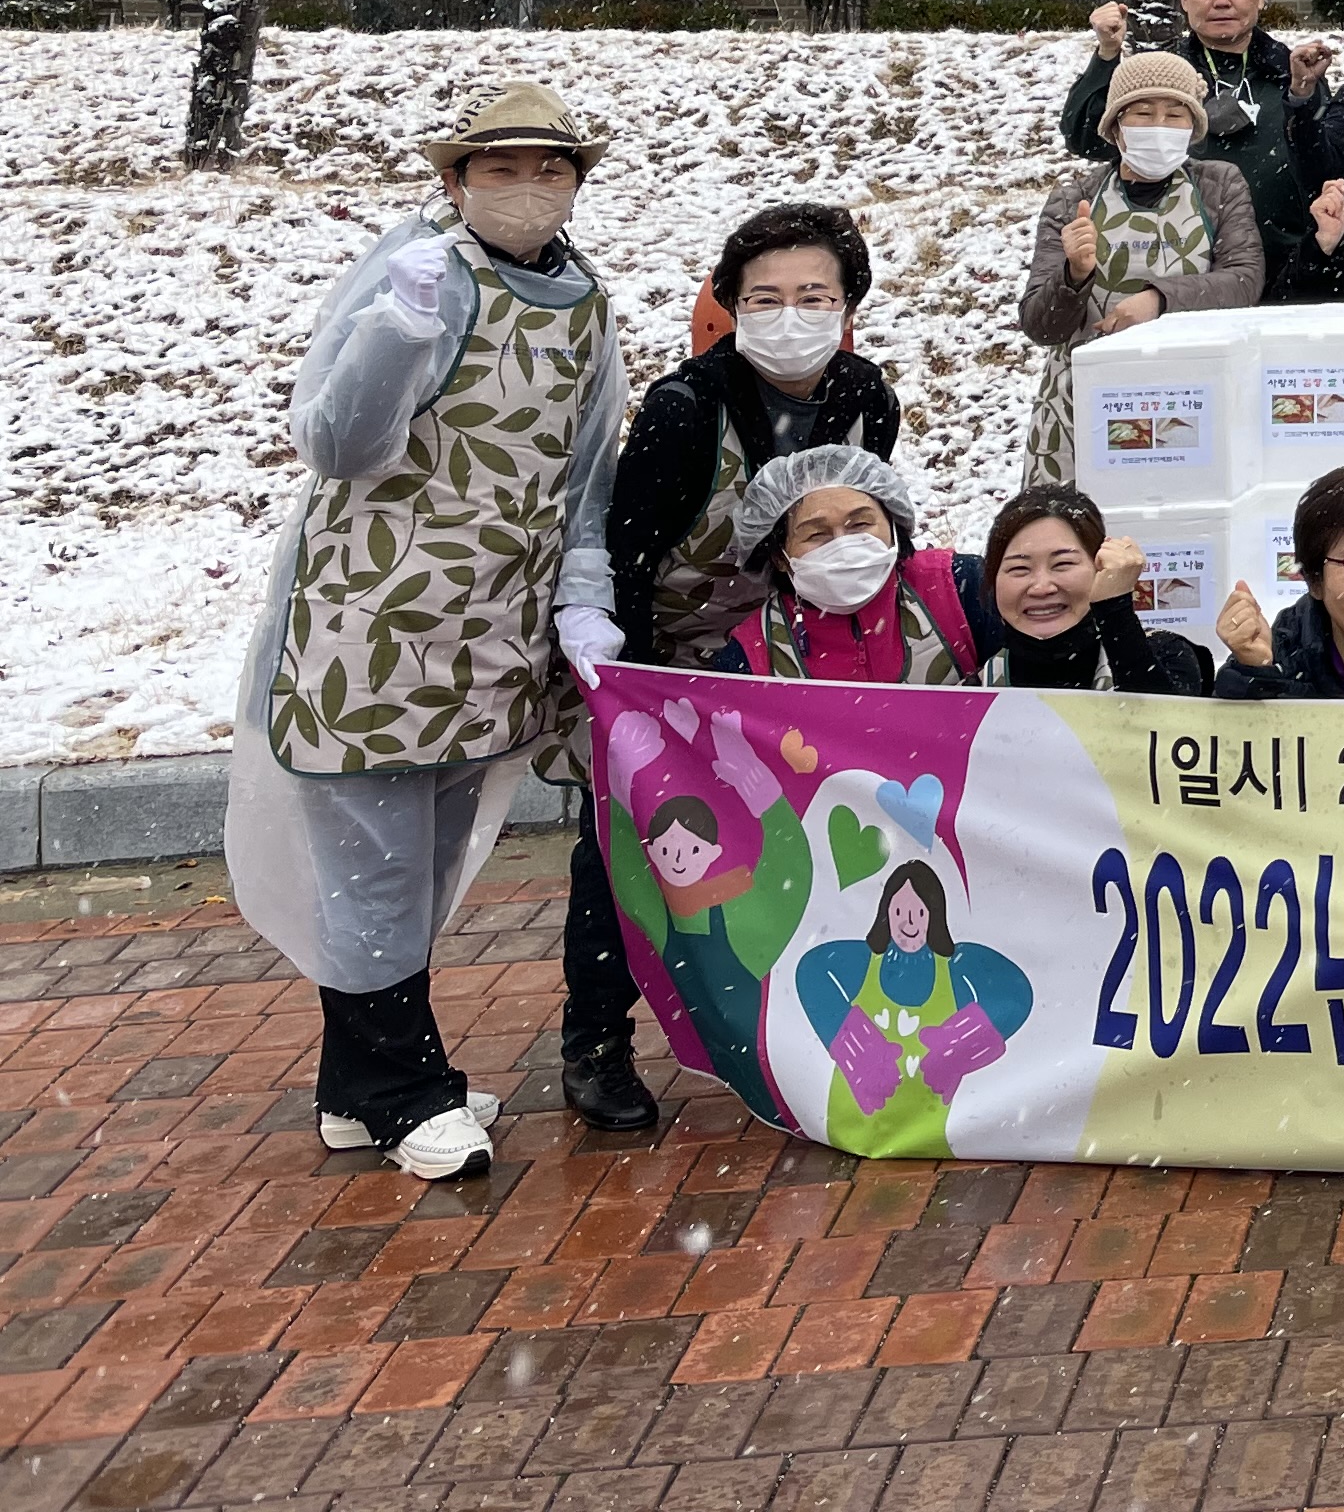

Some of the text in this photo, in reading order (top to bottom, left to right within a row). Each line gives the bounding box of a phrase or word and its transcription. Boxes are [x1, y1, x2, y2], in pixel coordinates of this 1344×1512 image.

[1267, 378, 1297, 388] 사랑의
[1102, 401, 1134, 413] 사랑의
[1182, 399, 1203, 410] 나눔
